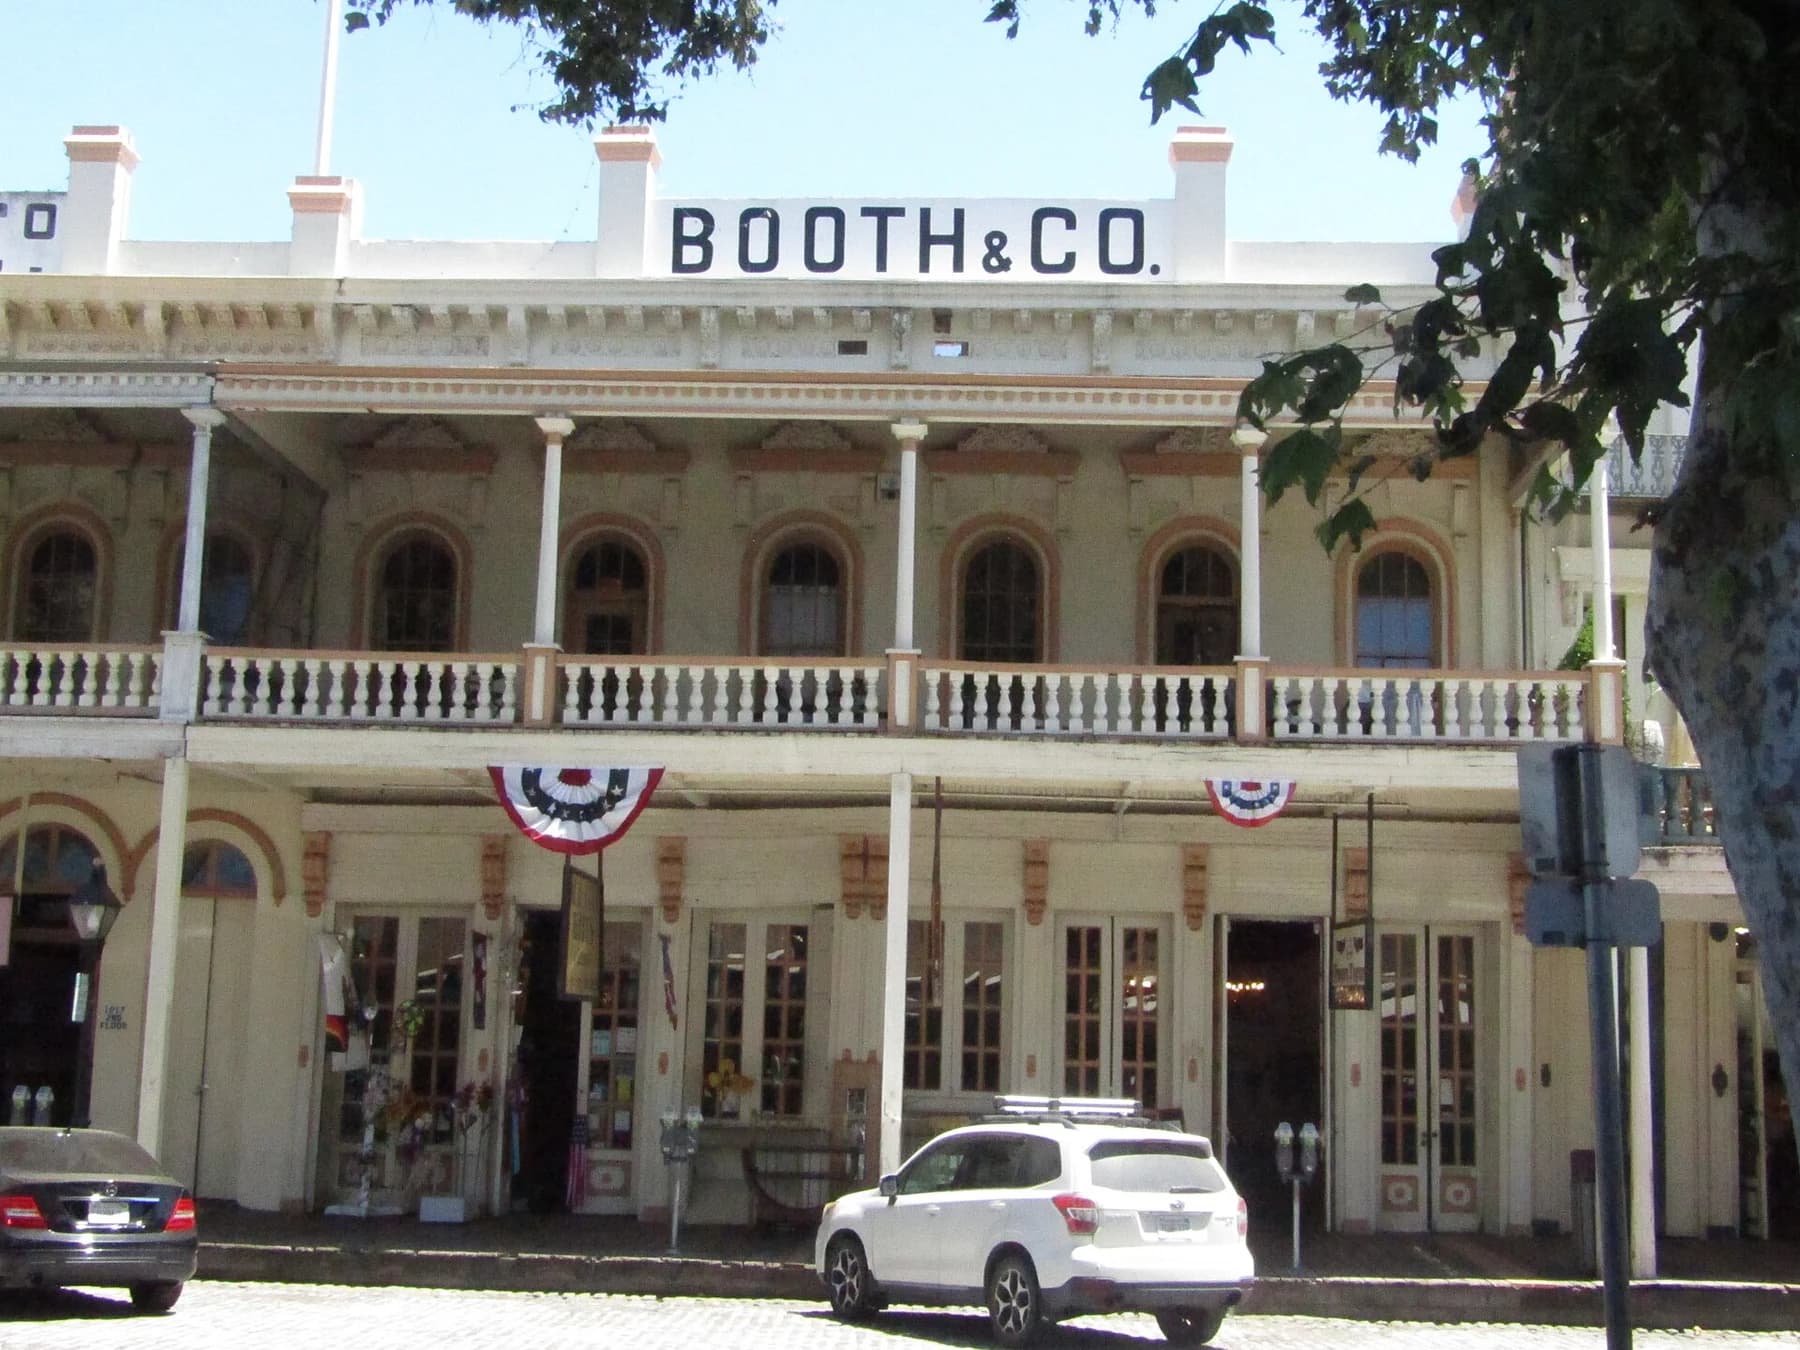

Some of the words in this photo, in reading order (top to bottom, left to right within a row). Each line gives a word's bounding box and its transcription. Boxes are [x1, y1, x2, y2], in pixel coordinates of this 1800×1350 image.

[672, 206, 965, 274] BOOTH
[982, 230, 1013, 274] &
[1031, 206, 1161, 276] CO.
[100, 1022, 128, 1030] FLOOR
